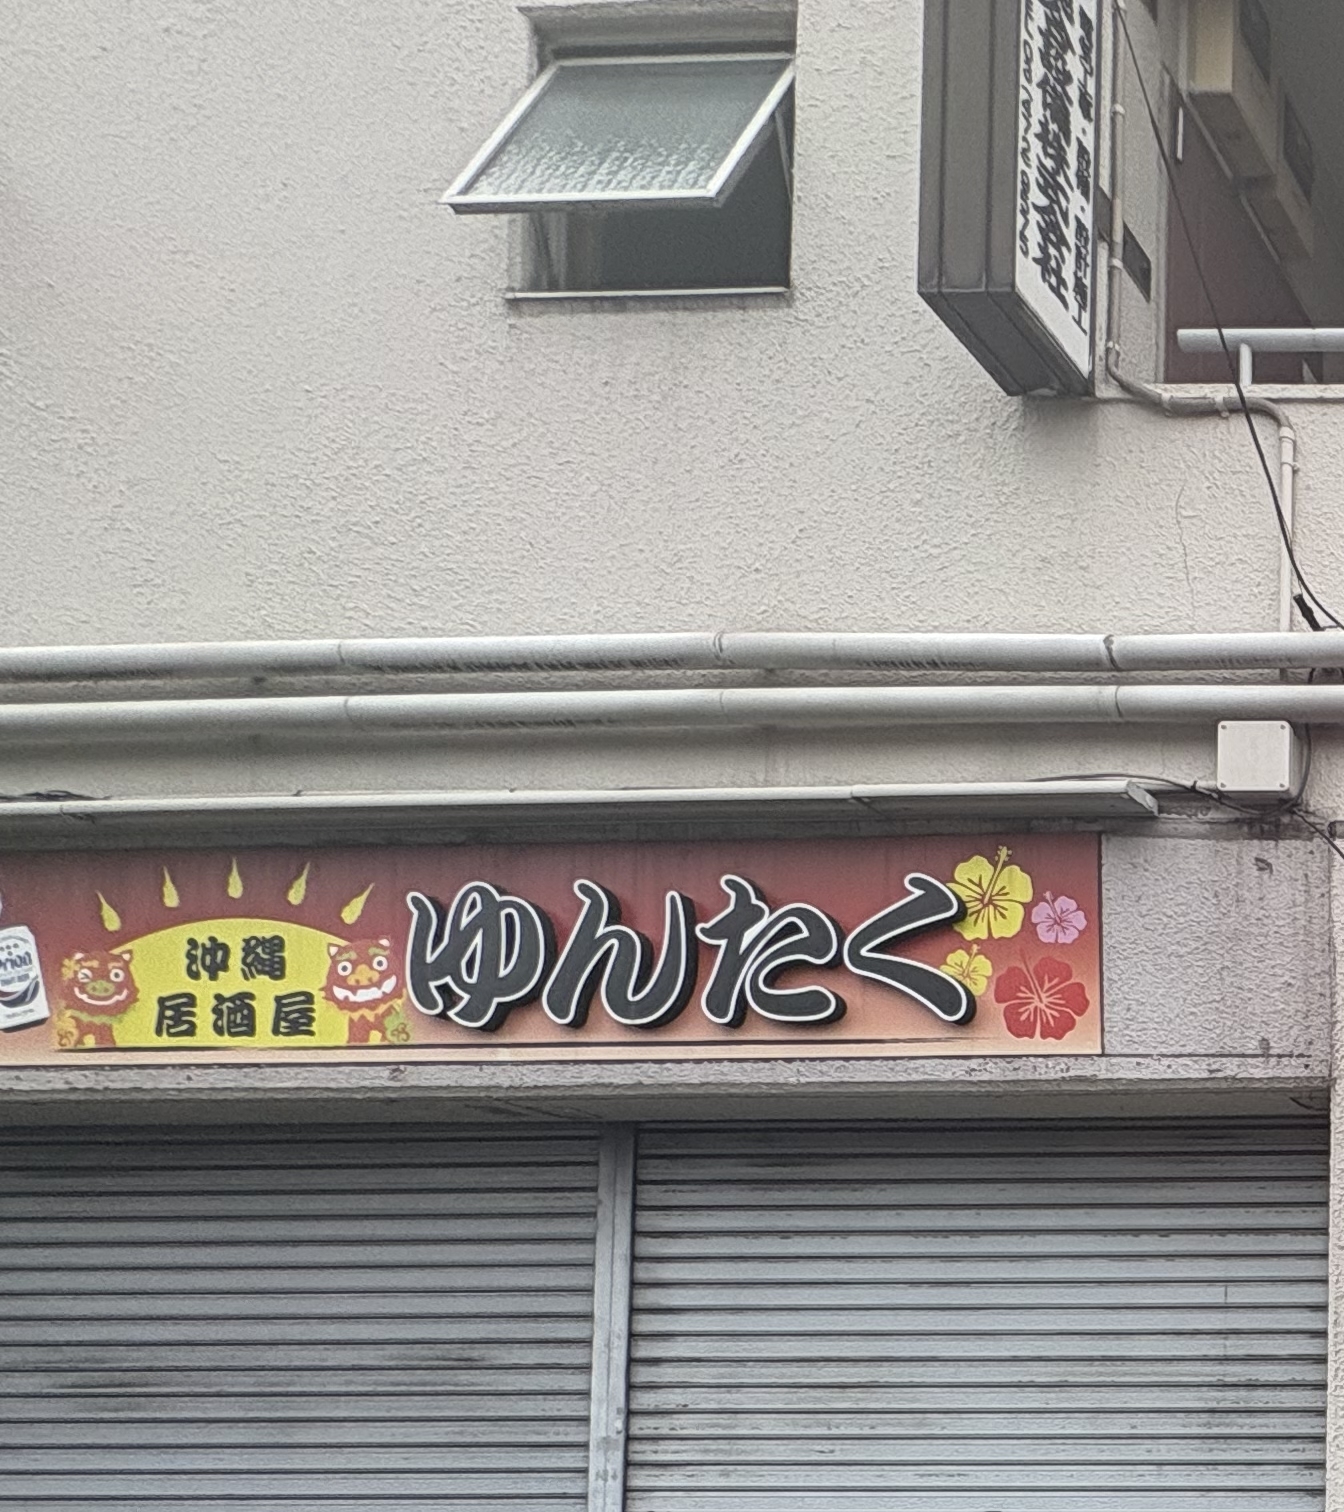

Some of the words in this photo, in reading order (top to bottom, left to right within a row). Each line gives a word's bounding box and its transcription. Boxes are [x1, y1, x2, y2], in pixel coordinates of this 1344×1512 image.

[1032, 0, 1076, 312] 合設備株式会社
[185, 936, 286, 980] 沖縄
[408, 872, 976, 1030] ゆんたく
[153, 990, 318, 1040] 居酒屋
